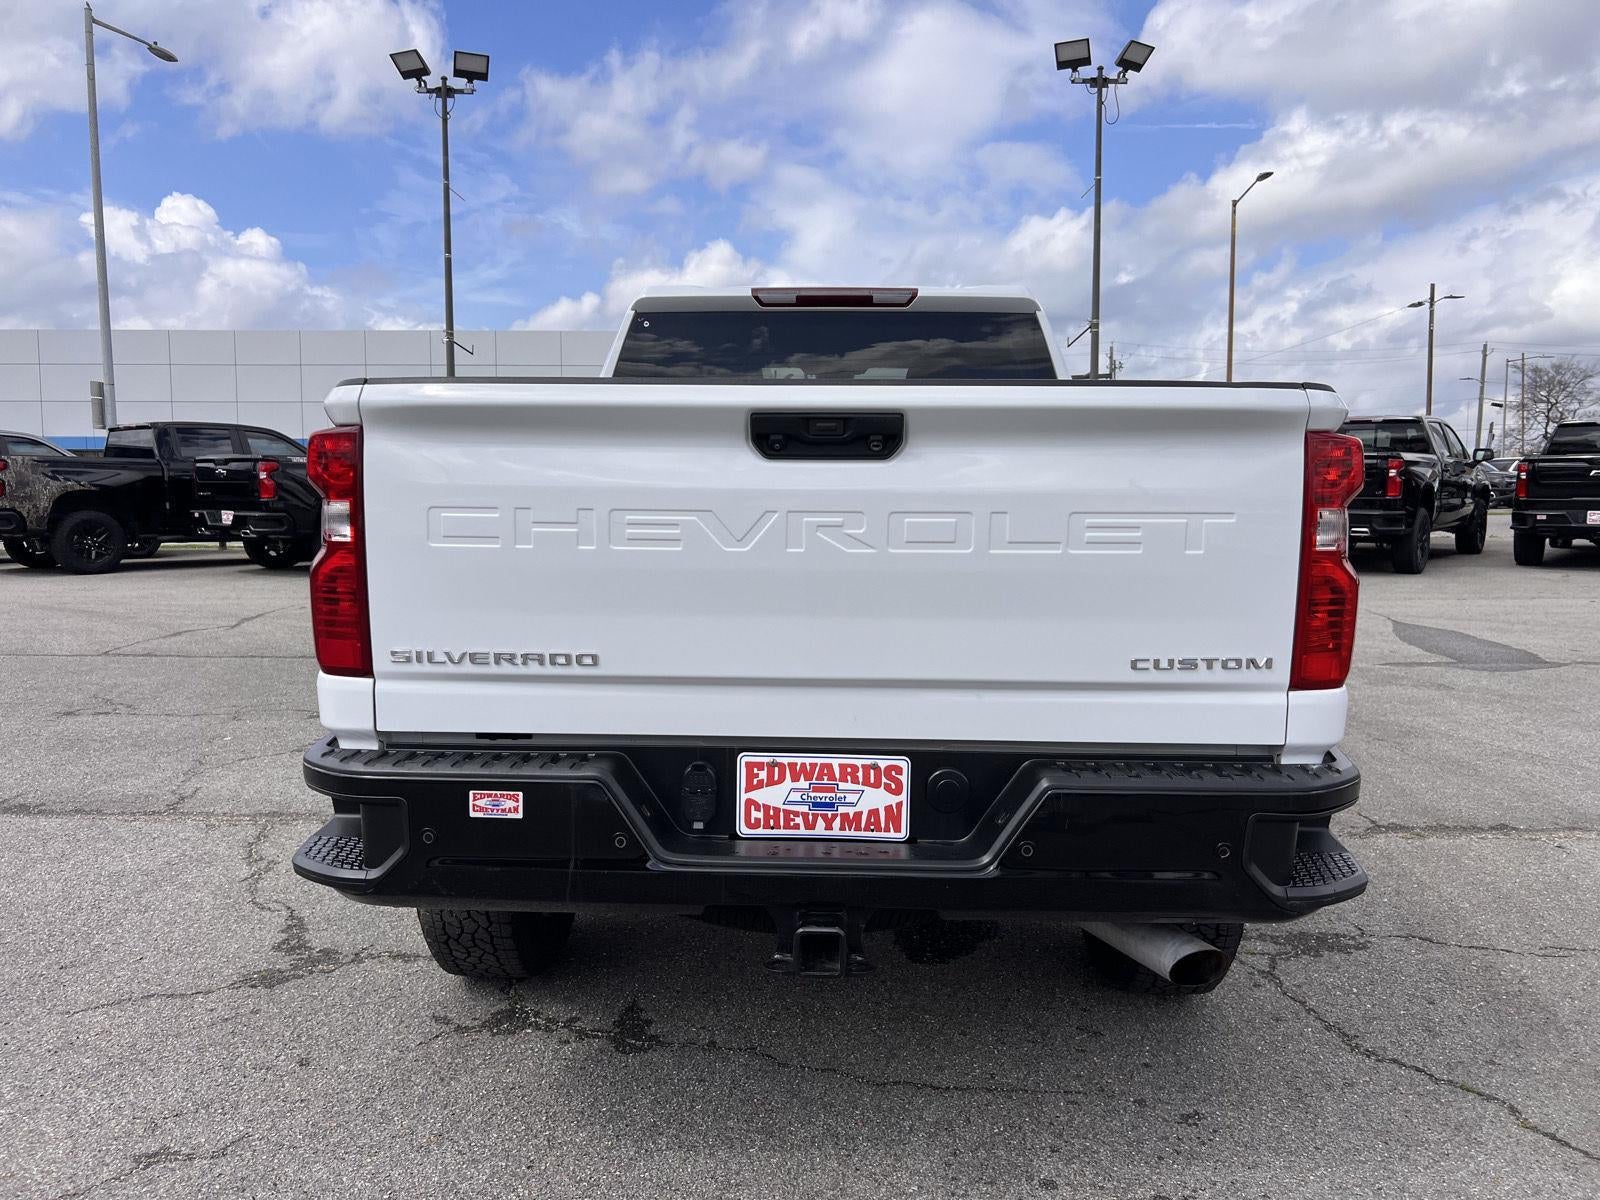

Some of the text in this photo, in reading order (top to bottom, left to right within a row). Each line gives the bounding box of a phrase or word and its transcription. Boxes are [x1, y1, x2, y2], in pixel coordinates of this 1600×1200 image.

[427, 506, 1236, 554] CHEVROLET
[390, 649, 599, 666] SILVERADO
[1130, 657, 1273, 670] CUSTOM
[744, 761, 904, 796] EDWARDS
[472, 792, 519, 803] EDWARDS
[800, 793, 847, 802] Chevrolet
[472, 803, 519, 814] CHEVYMAN
[744, 798, 903, 833] CHEVYMAN
